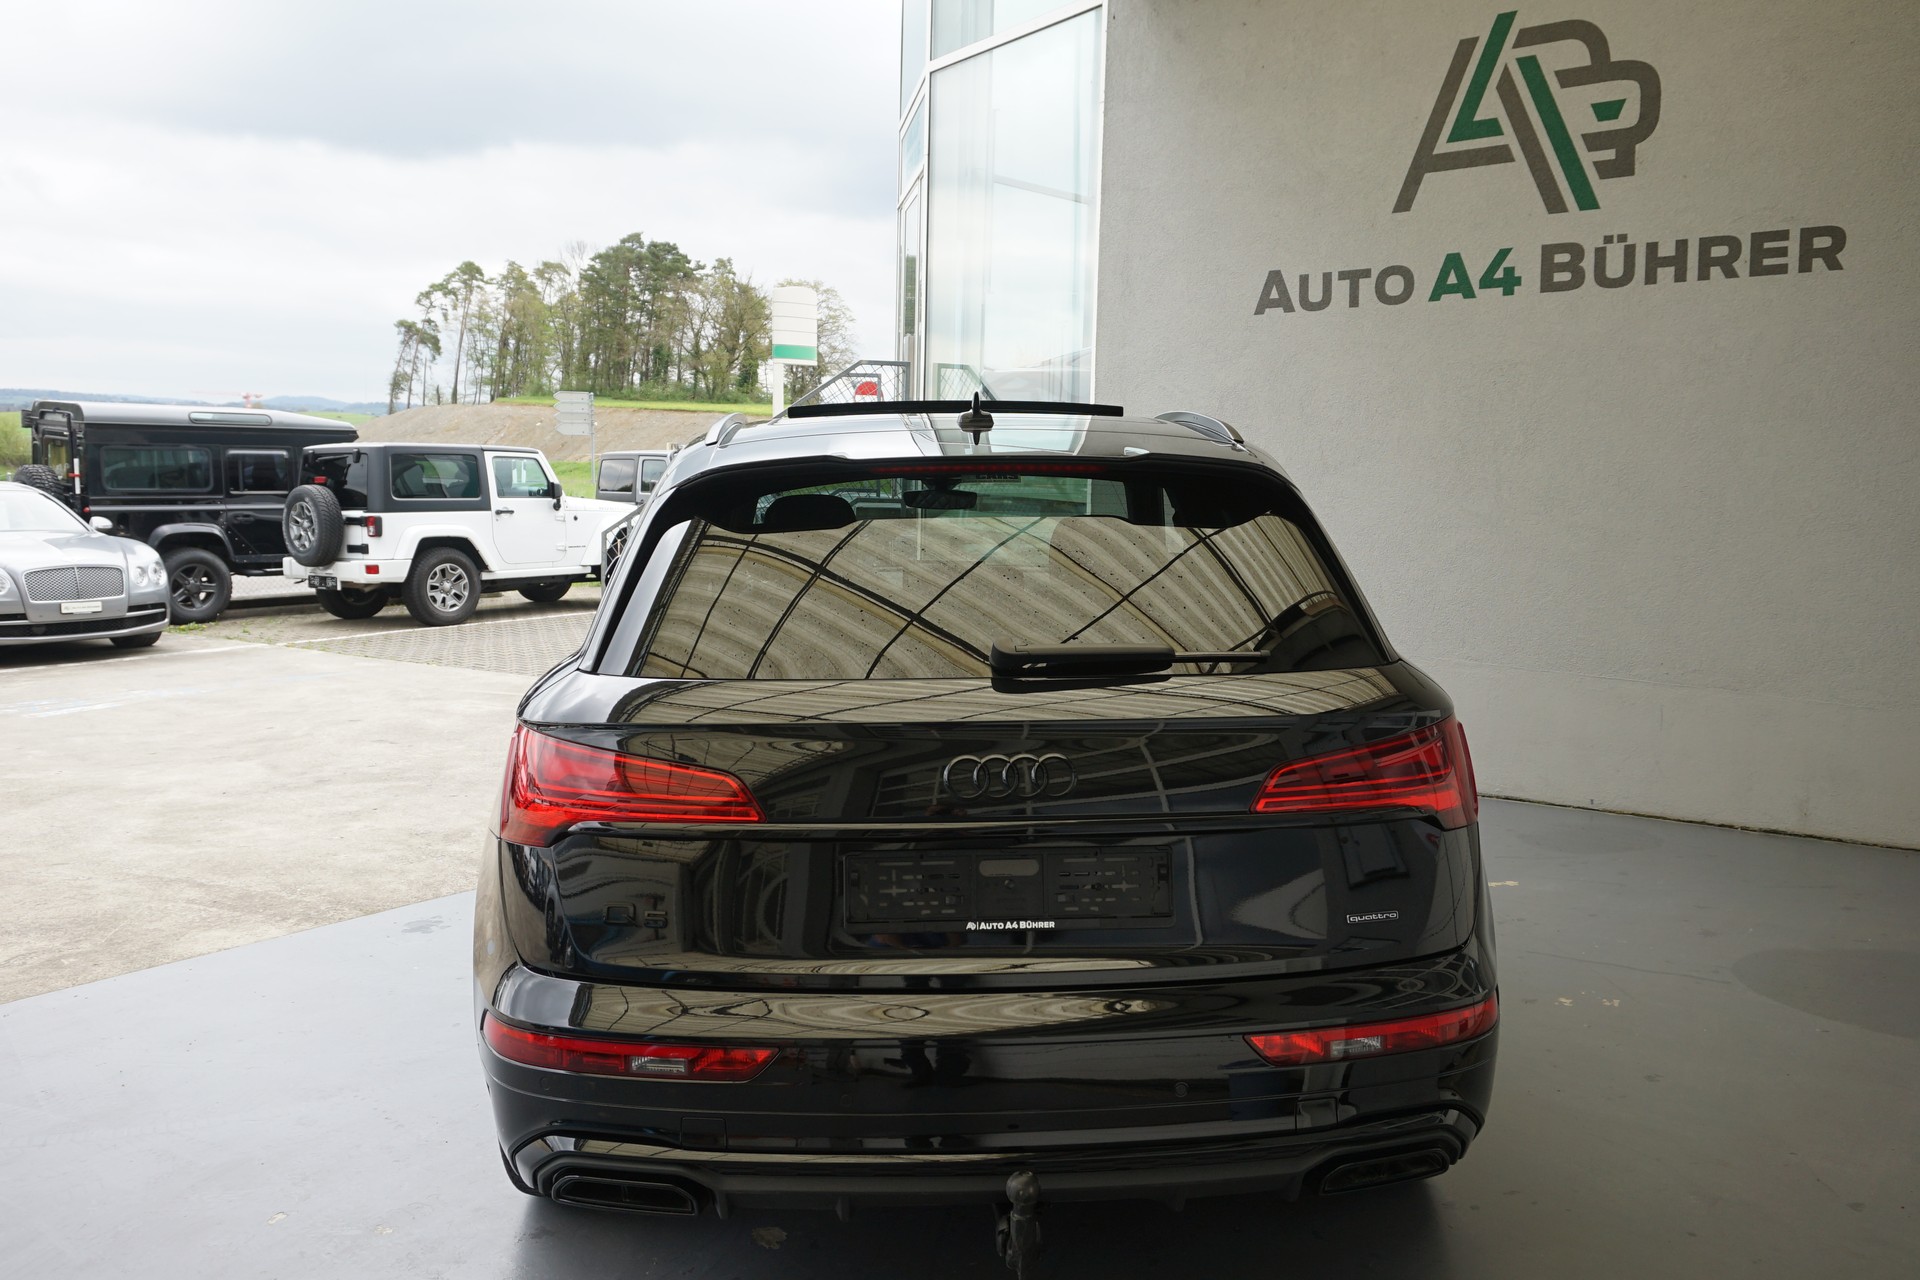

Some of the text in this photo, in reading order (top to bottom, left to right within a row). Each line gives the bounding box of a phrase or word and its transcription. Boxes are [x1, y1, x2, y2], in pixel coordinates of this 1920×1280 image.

[1253, 225, 1848, 316] AUTO A4 BÜHRER
[603, 901, 669, 928] Q5
[1349, 912, 1397, 922] quattro
[979, 921, 1004, 930] AUTO
[1005, 921, 1018, 930] A4
[1019, 920, 1055, 929] BÜHRER
